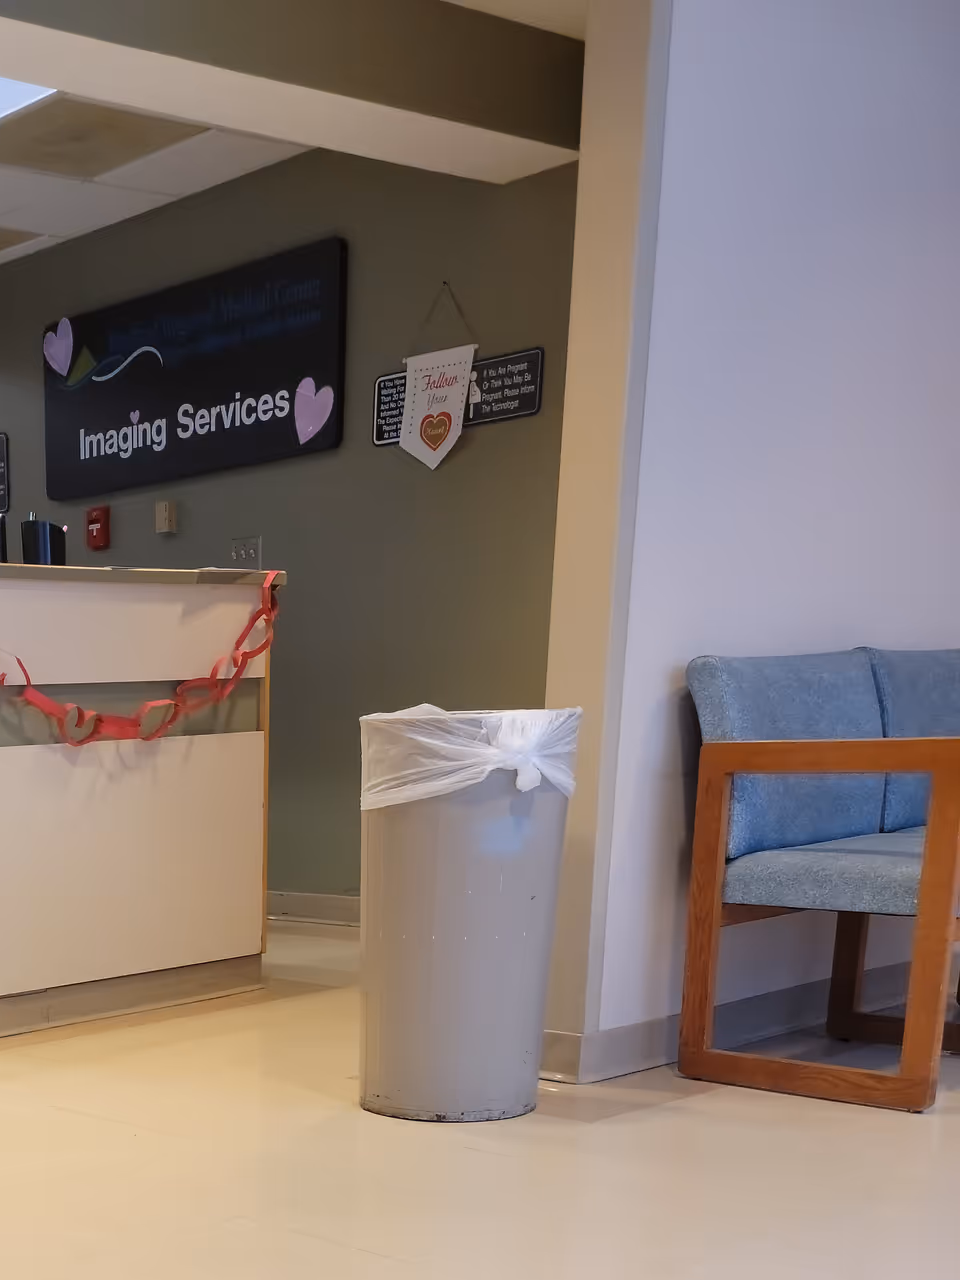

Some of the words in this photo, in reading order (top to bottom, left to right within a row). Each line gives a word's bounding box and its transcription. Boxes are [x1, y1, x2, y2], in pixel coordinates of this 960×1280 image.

[421, 372, 459, 392] Follow
[79, 416, 167, 459] Imaging
[176, 389, 290, 440] Services
